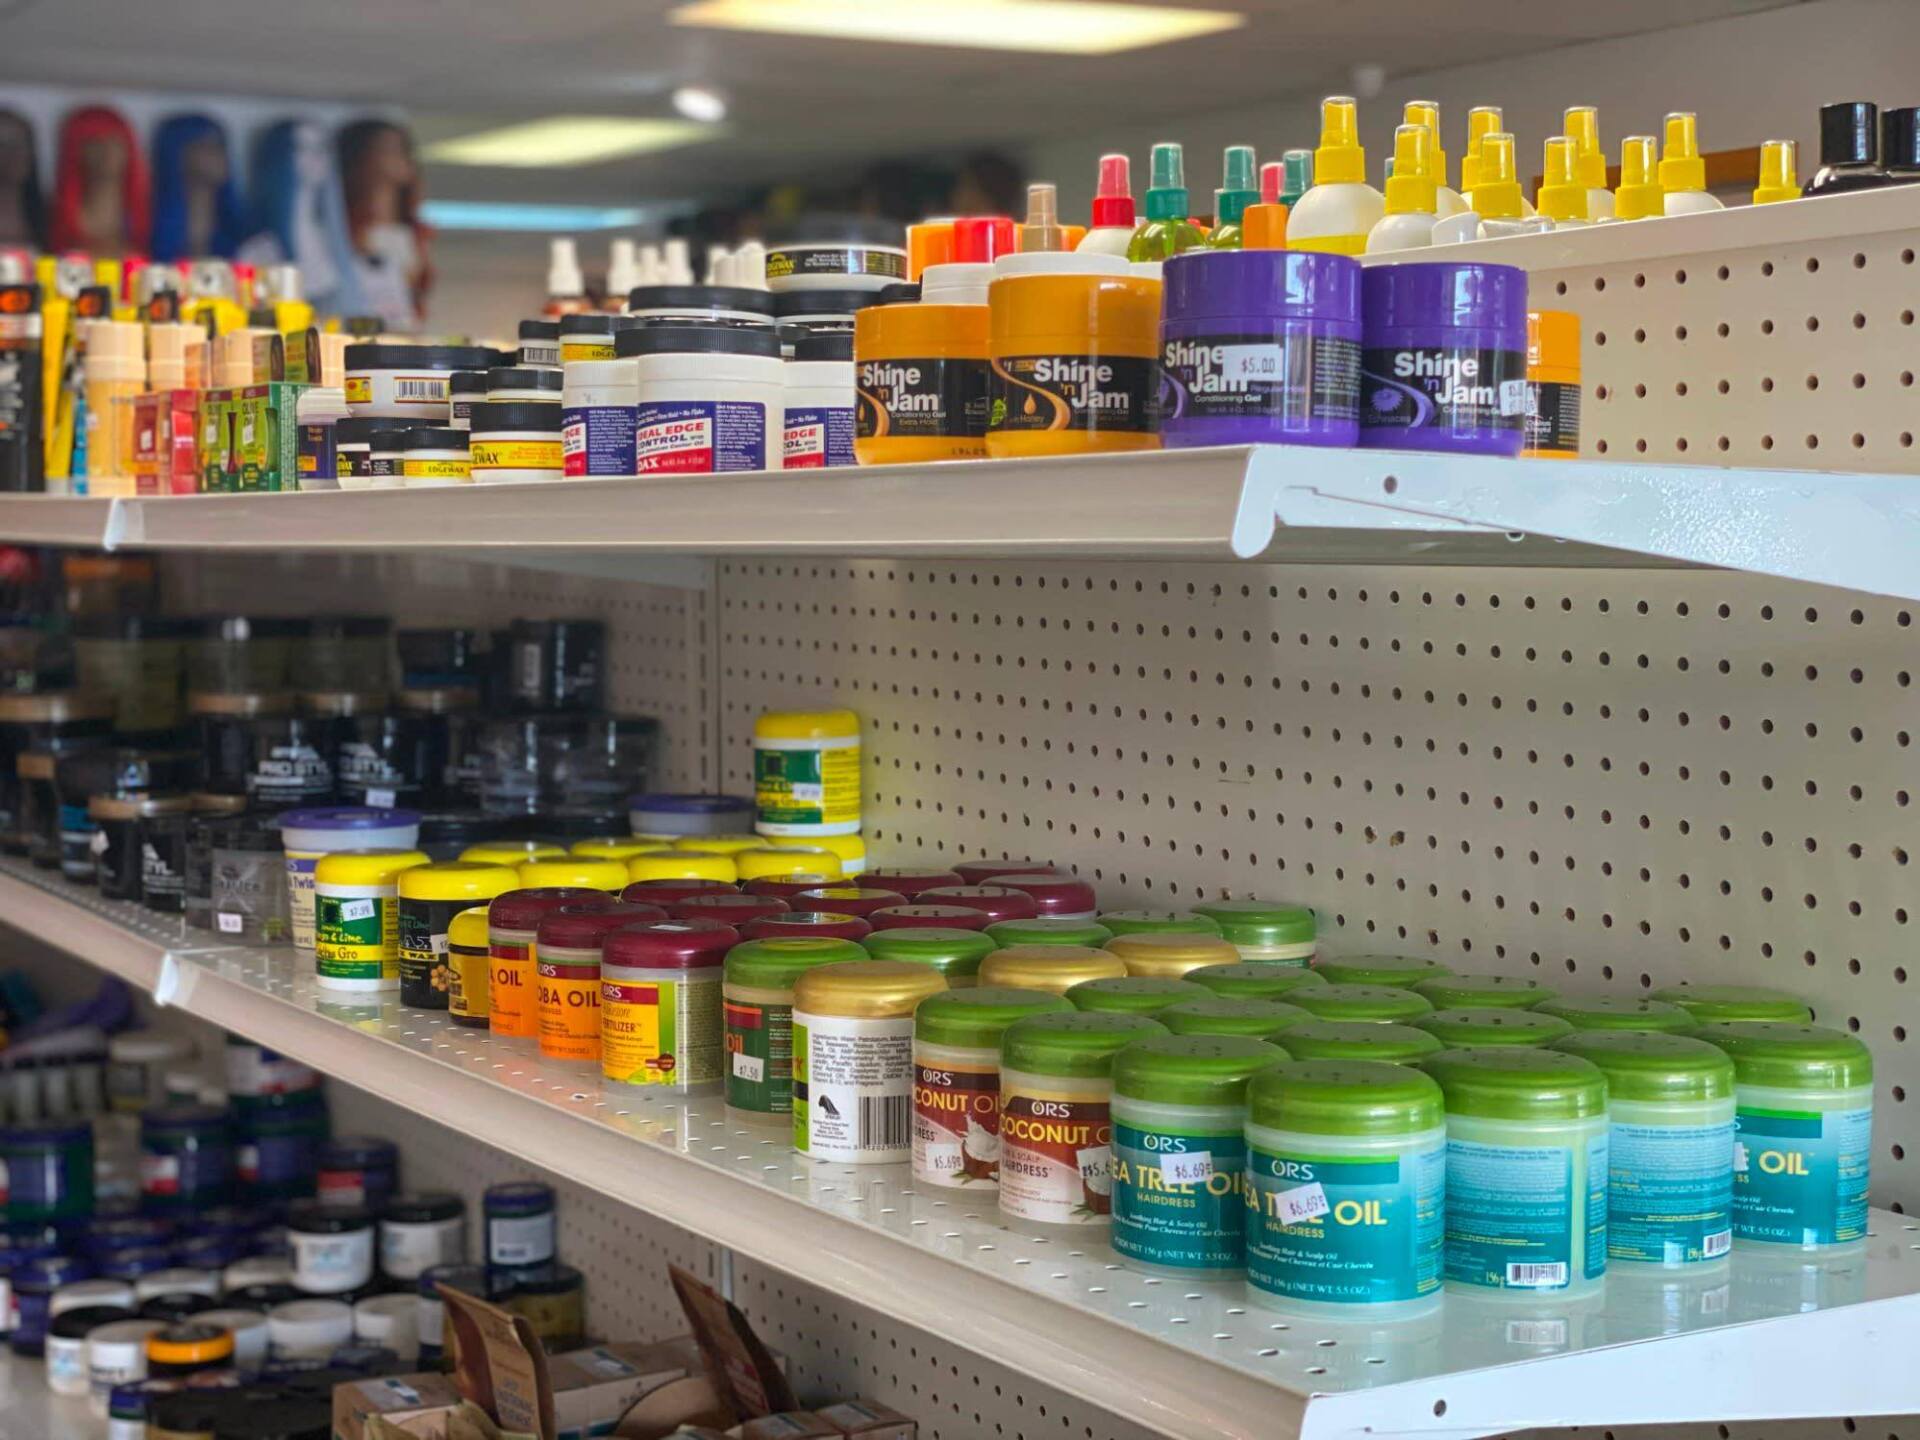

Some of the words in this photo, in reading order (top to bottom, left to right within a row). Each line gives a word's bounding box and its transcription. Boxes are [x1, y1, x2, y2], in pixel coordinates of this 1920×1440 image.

[1165, 341, 1224, 373] Shine
[1242, 358, 1276, 374] $5.00
[863, 362, 921, 393] Shine
[1034, 358, 1114, 392] Shine
[1394, 351, 1479, 386] Shine
[1189, 366, 1248, 393] Jam
[886, 386, 939, 412] Jam
[1071, 383, 1129, 409] Jam
[1244, 394, 1262, 403] Gel
[1435, 377, 1494, 405] Jam
[664, 422, 704, 435] EDGE
[338, 946, 358, 960] Gro
[497, 968, 523, 987] OIL
[567, 989, 602, 1008] OIL
[726, 1032, 743, 1053] Oil
[923, 1069, 952, 1086] ORS
[915, 1087, 968, 1112] CONUT
[1031, 1101, 1071, 1118] ORS
[1000, 1113, 1090, 1144] COCONUT
[1144, 1134, 1187, 1153] ORS
[1272, 1160, 1315, 1181] ORS
[1758, 1150, 1810, 1176] OIL
[1137, 1192, 1196, 1208] HAIRDRESS
[1334, 1200, 1388, 1226] OIL
[1265, 1220, 1325, 1239] HAIRDRESS
